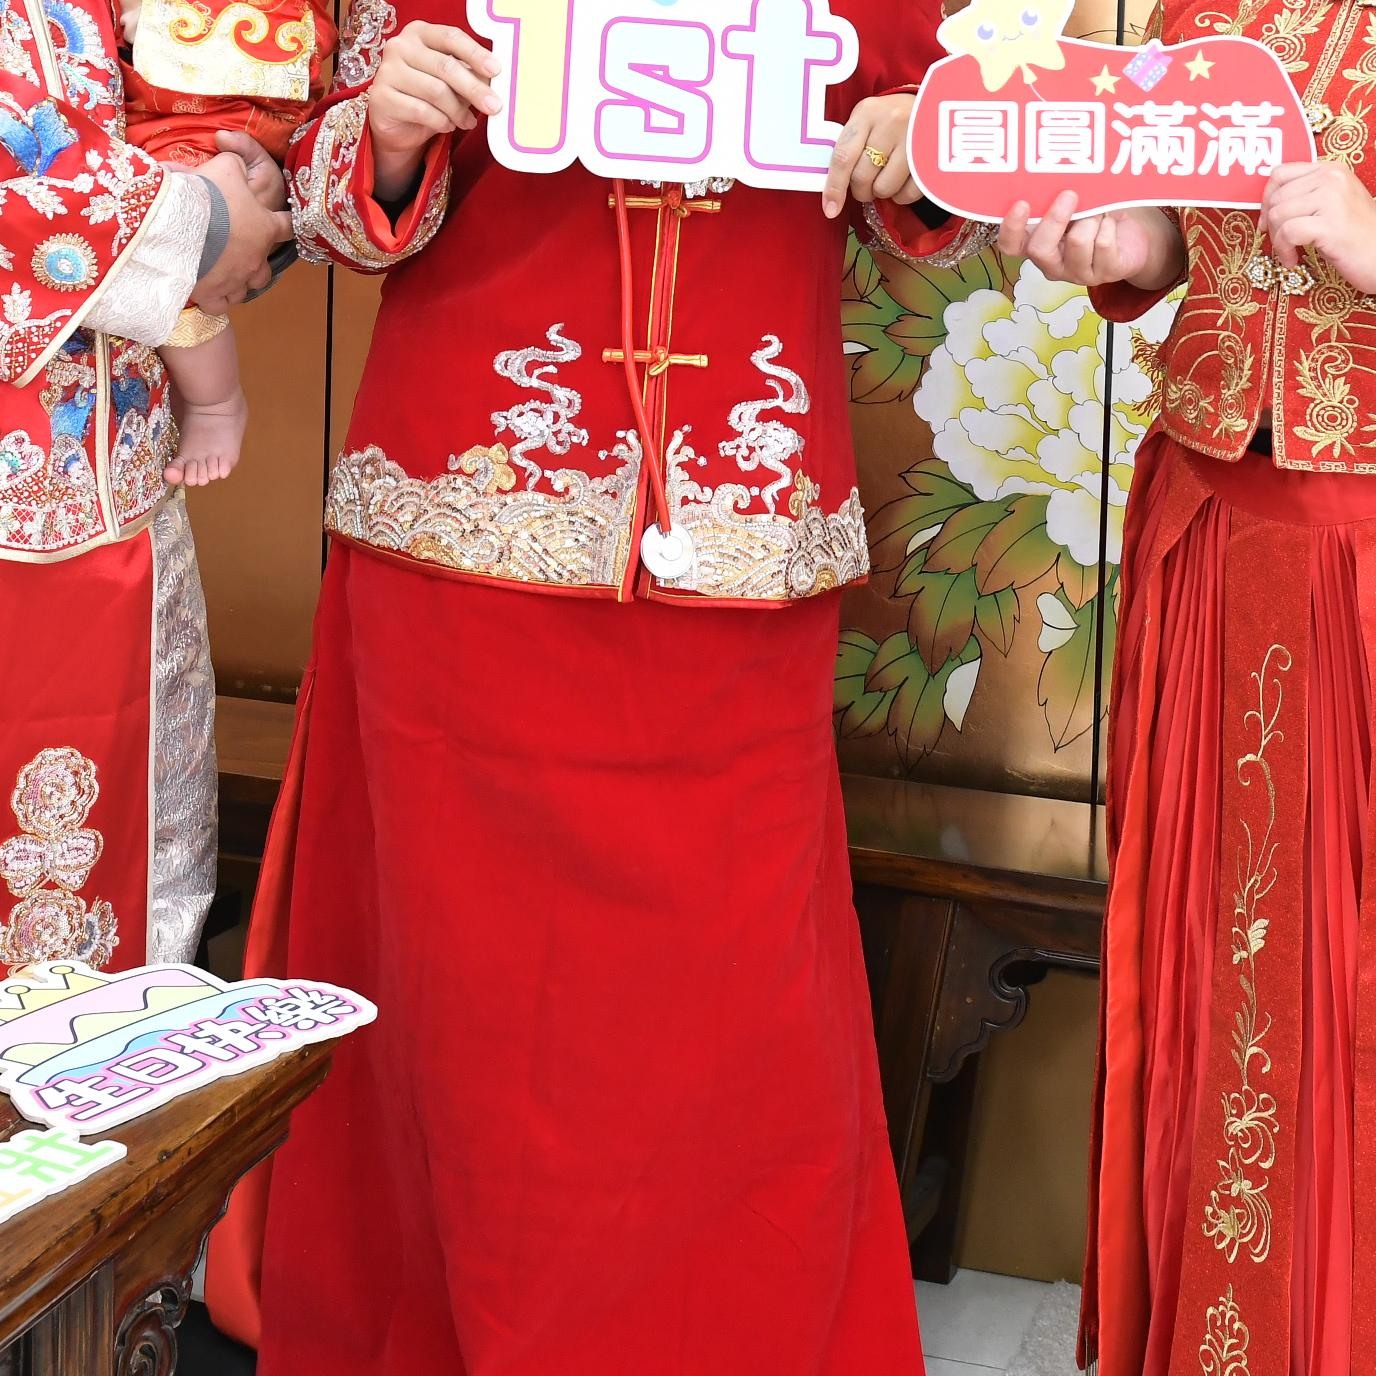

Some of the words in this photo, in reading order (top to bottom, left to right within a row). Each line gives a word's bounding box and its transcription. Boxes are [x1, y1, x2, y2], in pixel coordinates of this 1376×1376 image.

[937, 100, 1286, 176] 圓圓滿滿
[36, 985, 358, 1121] 生日快樂
